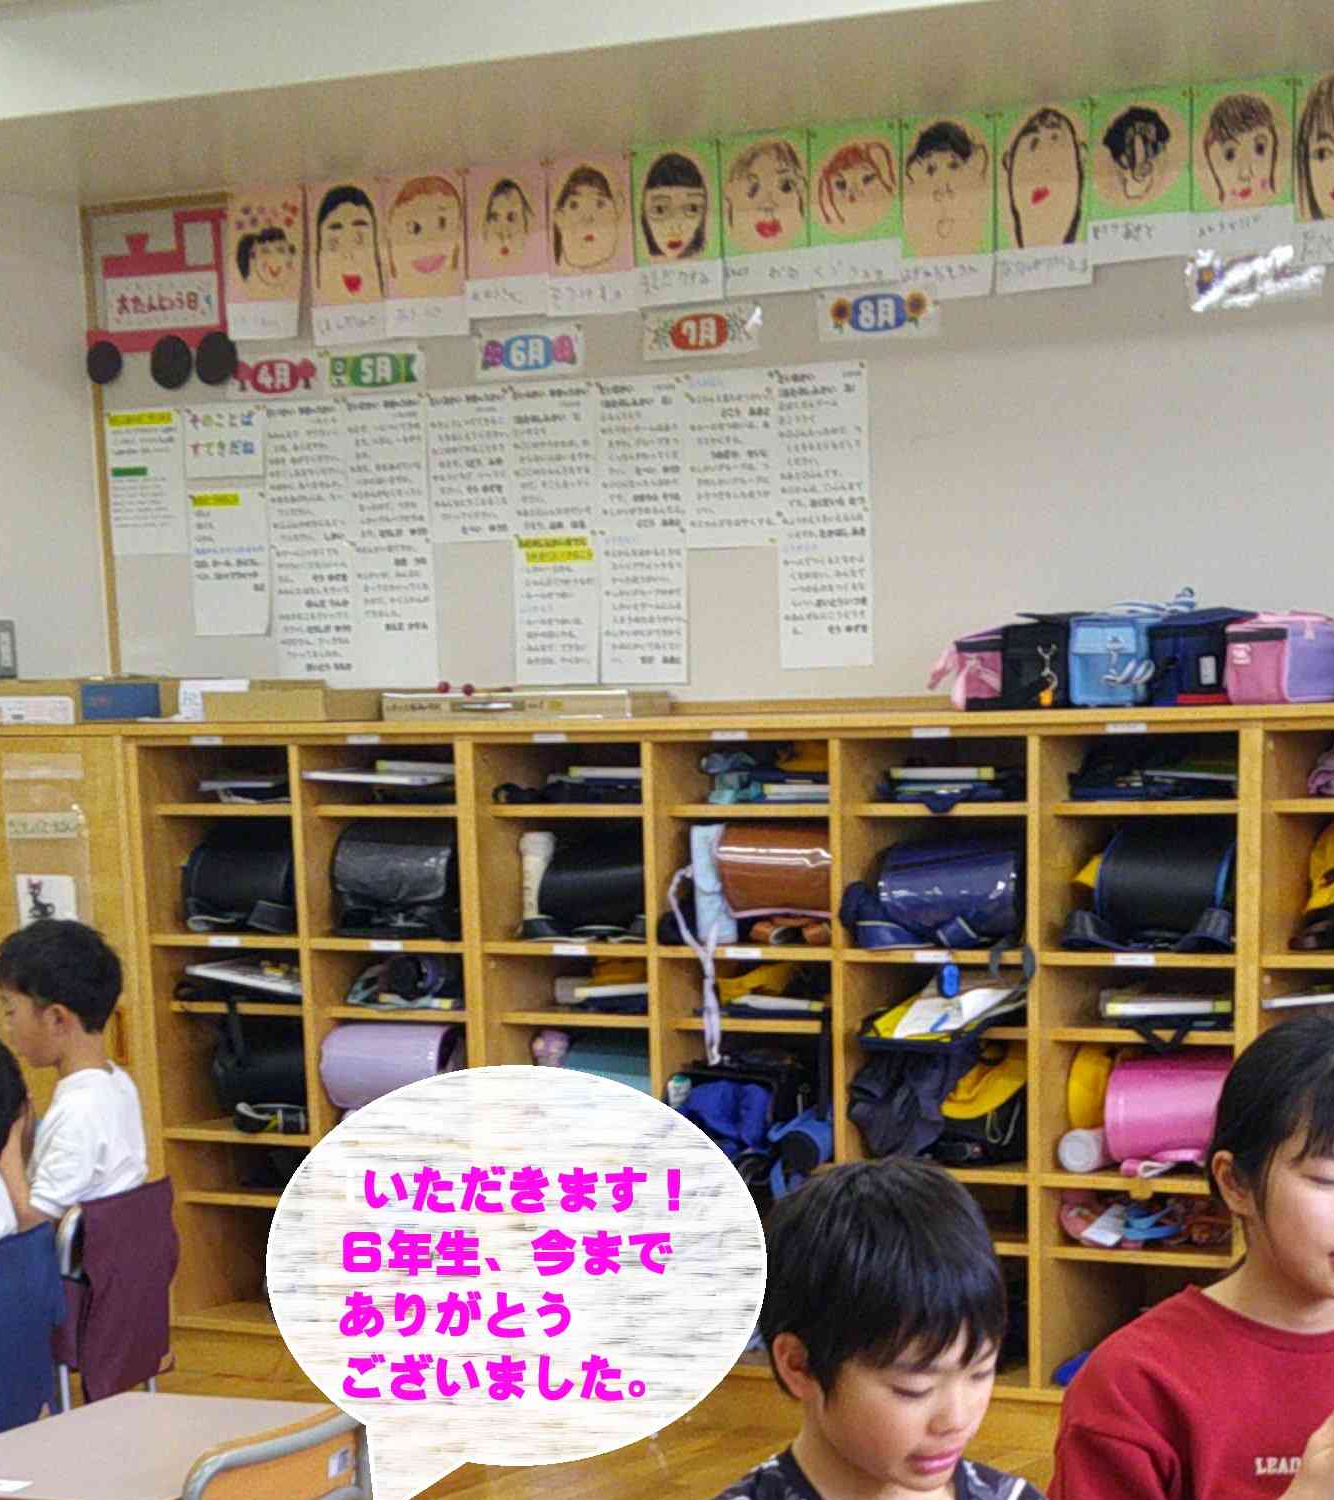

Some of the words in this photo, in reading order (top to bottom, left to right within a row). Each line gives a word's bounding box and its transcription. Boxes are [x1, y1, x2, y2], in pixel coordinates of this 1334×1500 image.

[857, 300, 895, 328] 8月
[509, 337, 547, 367] 6月
[256, 363, 292, 391] 4月
[360, 355, 393, 383] 5月
[189, 411, 255, 431] そのことば
[187, 440, 255, 458] すてきだね
